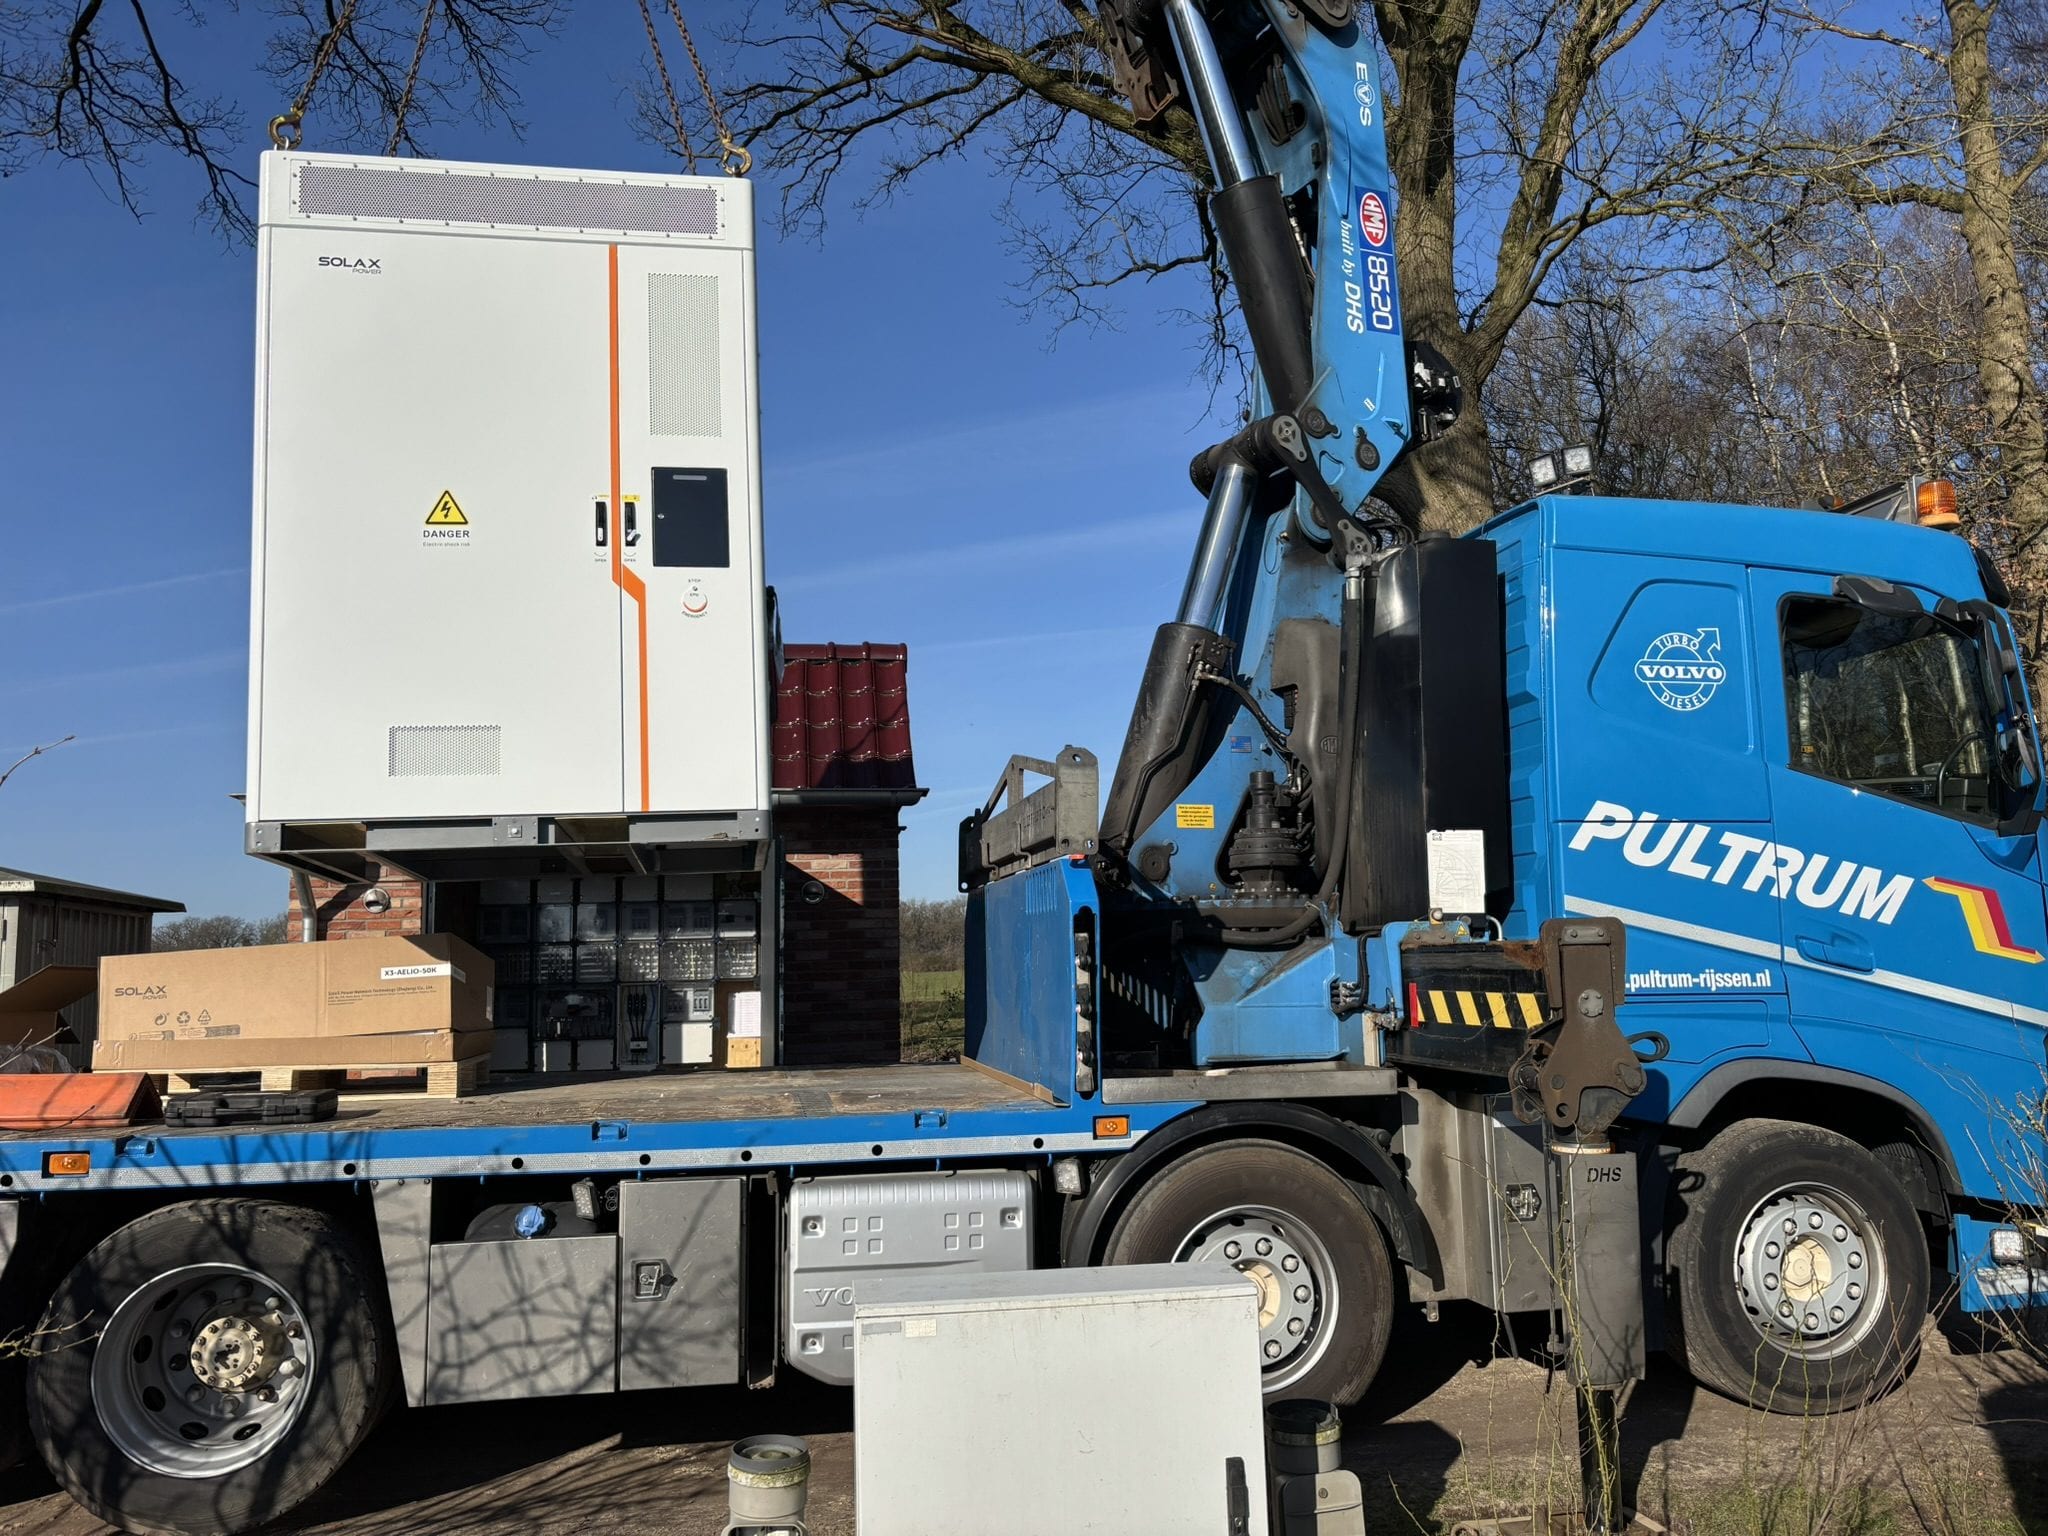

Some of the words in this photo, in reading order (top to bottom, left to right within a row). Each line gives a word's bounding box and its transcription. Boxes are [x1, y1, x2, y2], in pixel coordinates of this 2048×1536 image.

[1362, 198, 1385, 241] HMF
[1340, 220, 1355, 256] built
[318, 256, 381, 269] SOLAX
[1341, 258, 1356, 277] by
[352, 267, 382, 275] POWER
[1367, 255, 1393, 331] 8520
[1344, 281, 1364, 335] DHS
[423, 530, 470, 538] DANGER
[1655, 634, 1700, 650] TURBO
[1638, 665, 1723, 680] VOLVO
[1660, 692, 1706, 709] DIESEL
[1568, 800, 1915, 926] PULTRUM
[384, 967, 437, 977] X3-AELIO-50K
[1625, 969, 1771, 992] .pultrum-rijssen.nl
[114, 985, 167, 997] SOLAX
[1587, 1167, 1622, 1183] DHS
